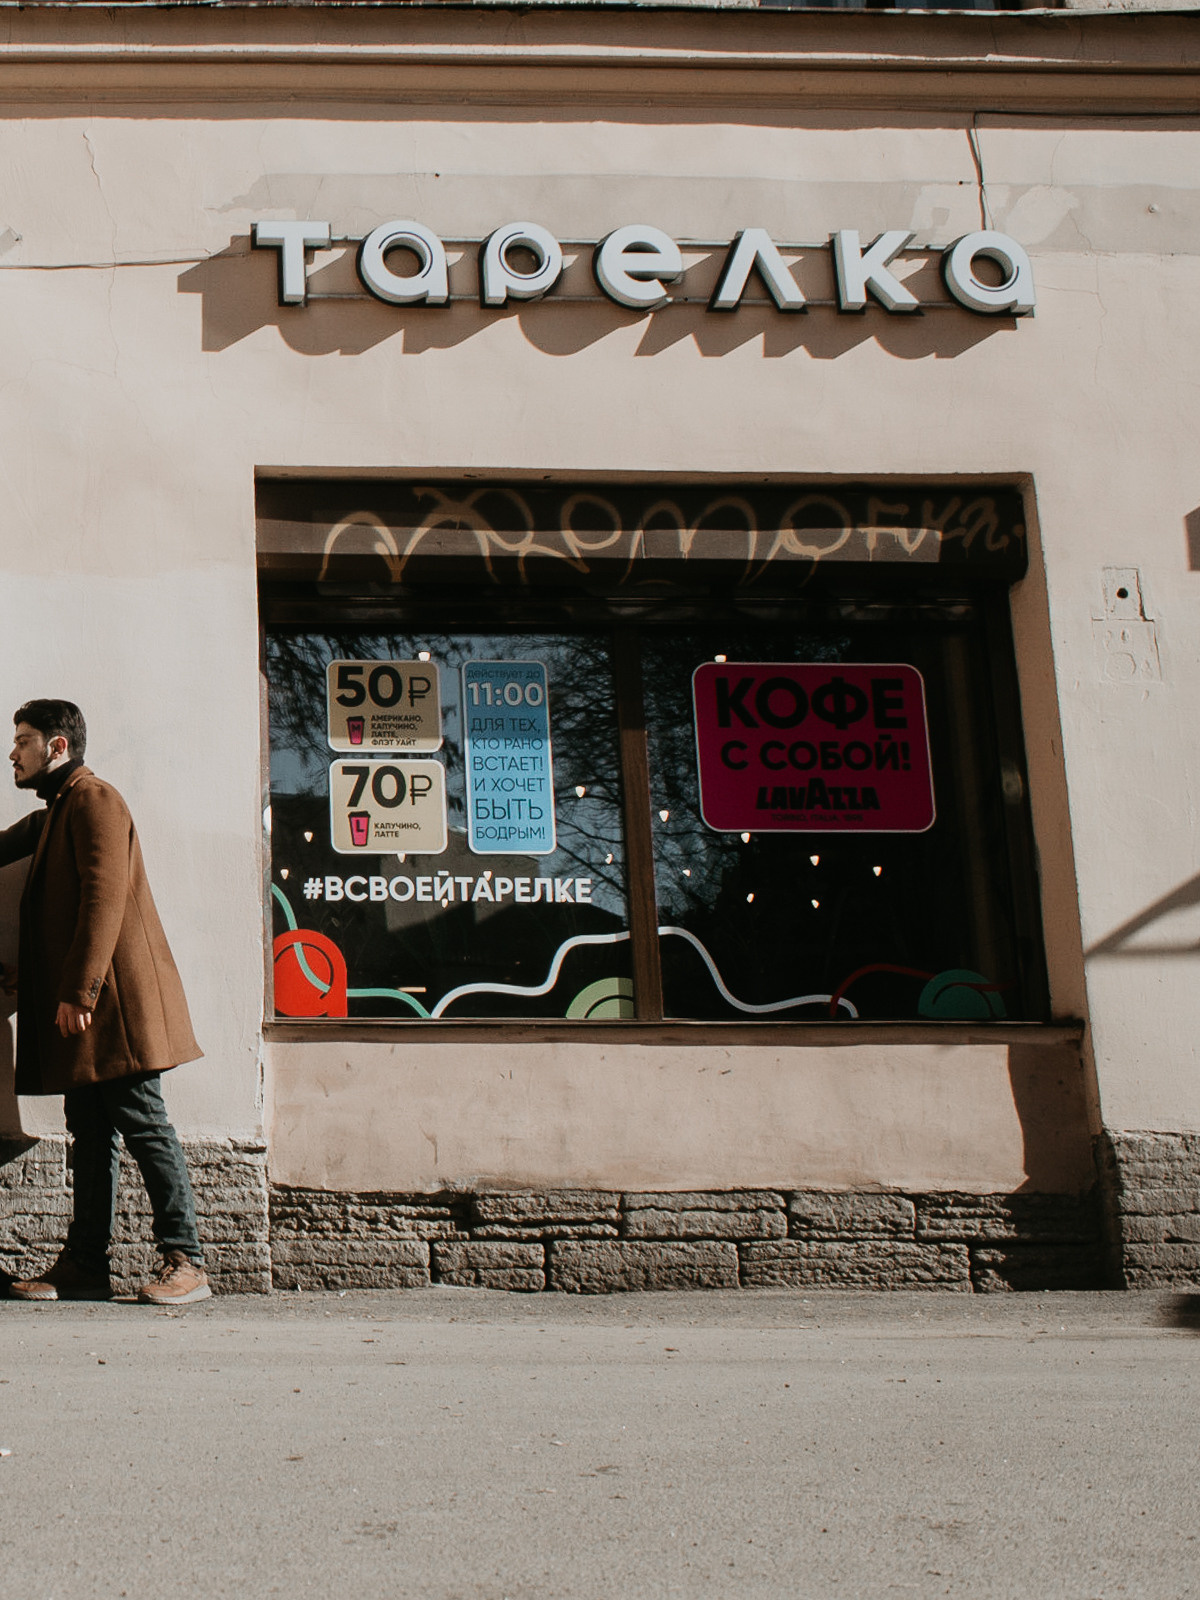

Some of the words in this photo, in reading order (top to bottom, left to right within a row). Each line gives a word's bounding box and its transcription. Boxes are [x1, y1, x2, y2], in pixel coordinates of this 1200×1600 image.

[467, 682, 544, 707] 11:00
[714, 677, 908, 730] КОФЕ
[371, 715, 423, 723] АМЕРИКАНО,
[471, 718, 504, 733] ДЛЯ
[509, 718, 541, 733] ТЕХ,
[371, 723, 418, 731] КАПУЧИНО,
[396, 738, 416, 746] УАЙТ
[472, 738, 500, 750] КТО
[504, 738, 543, 750] РАНО
[721, 740, 748, 770] С
[759, 734, 912, 771] СОБОЙ!
[473, 756, 543, 771] ВСТАЕТ!
[474, 778, 486, 791] И
[491, 778, 545, 792] ХОЧЕТ
[756, 778, 881, 810] LAVAZZA
[476, 798, 543, 820] БЫТЬ
[356, 820, 365, 832] L
[374, 823, 421, 831] КАПУЧИНО,
[476, 826, 546, 840] БОДРЫМ!
[303, 870, 592, 903] #ВСВОЕЙТАРЕЛКЕ
